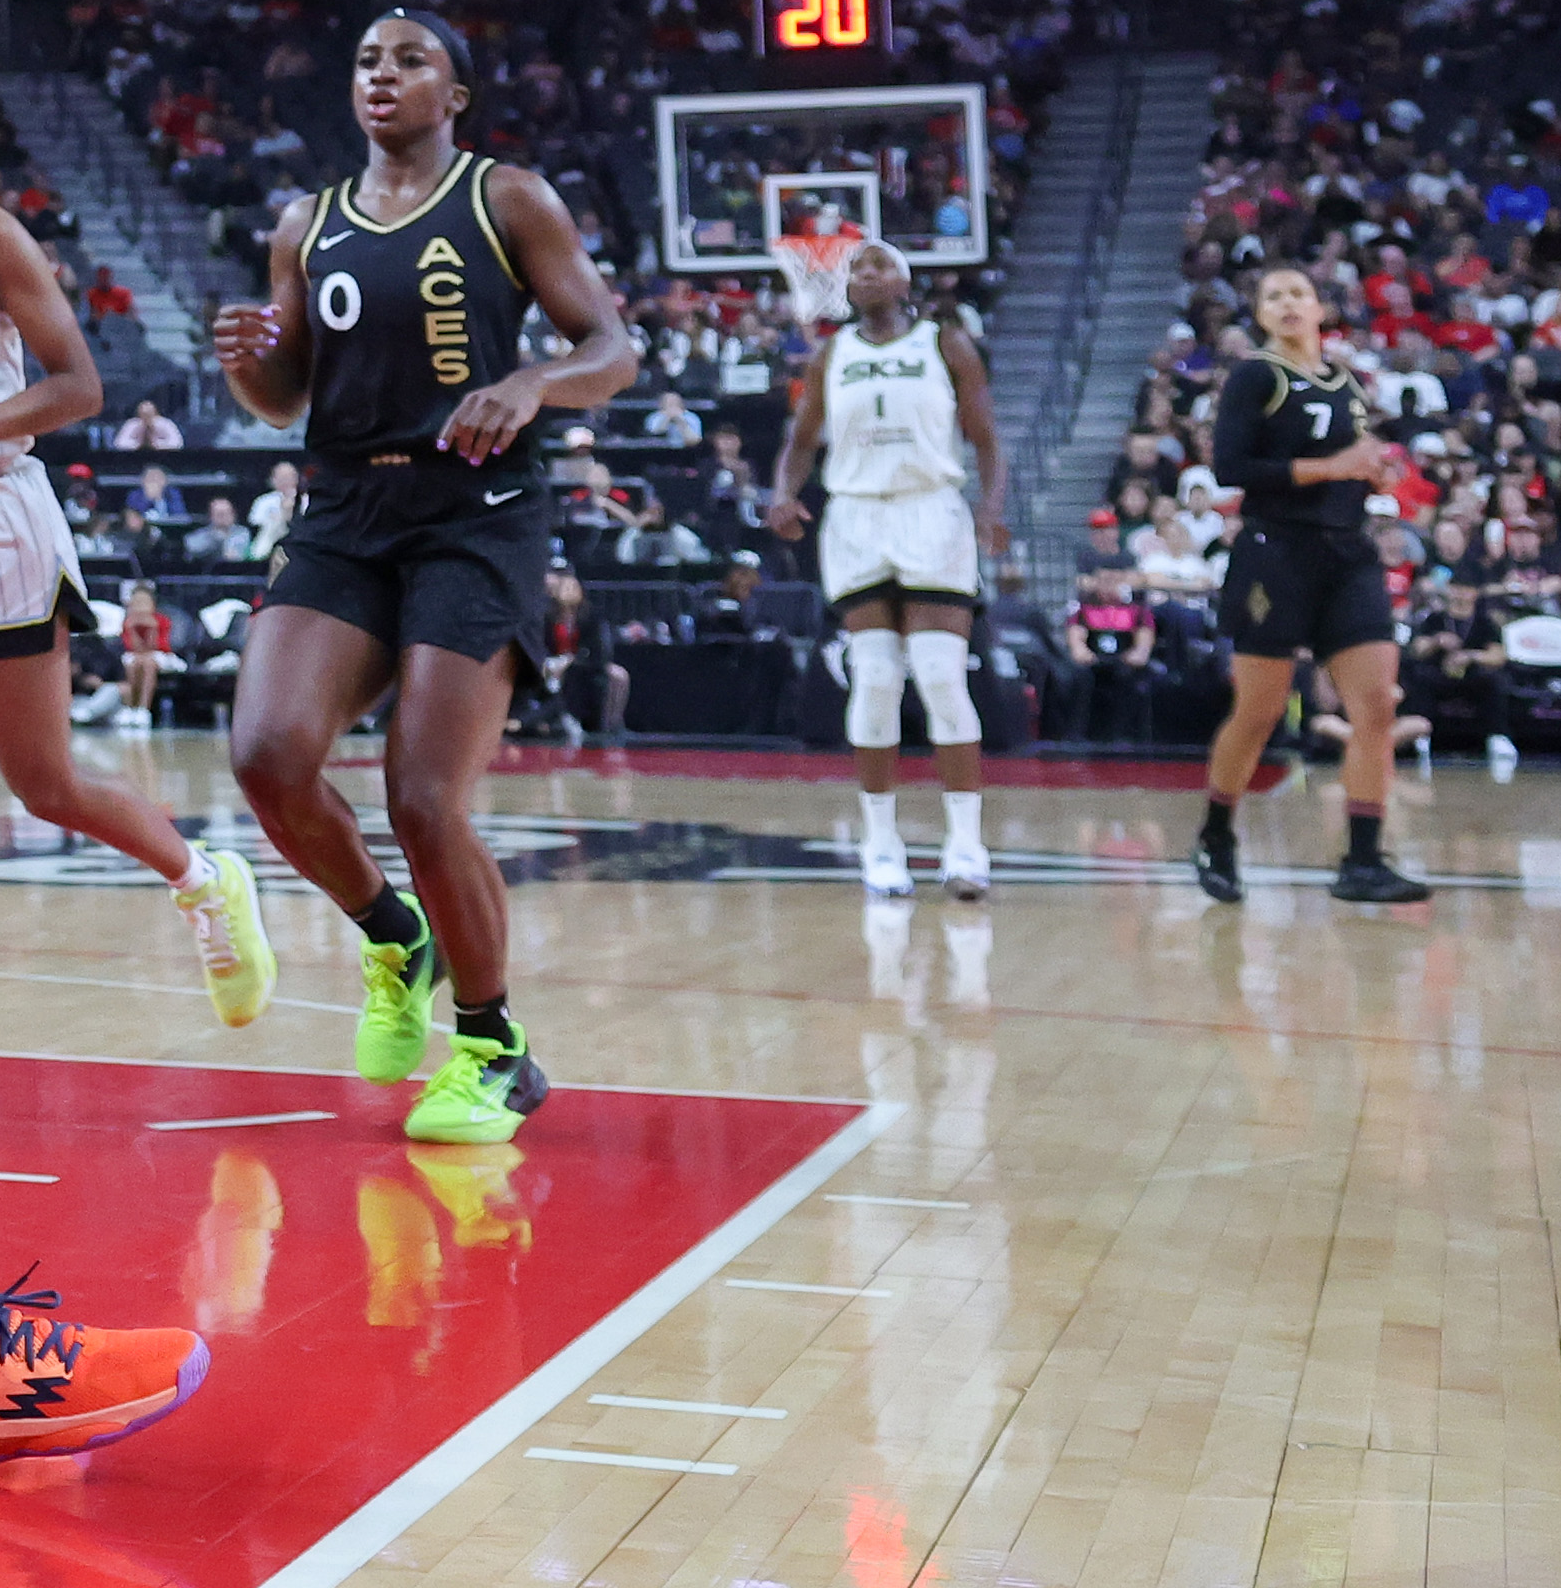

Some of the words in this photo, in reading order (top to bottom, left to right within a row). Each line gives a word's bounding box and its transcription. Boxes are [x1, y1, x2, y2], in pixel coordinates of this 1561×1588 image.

[317, 270, 363, 332] 0
[416, 235, 471, 386] ACES
[839, 358, 926, 387] SKY
[874, 393, 886, 420] 1
[1302, 401, 1333, 441] 7
